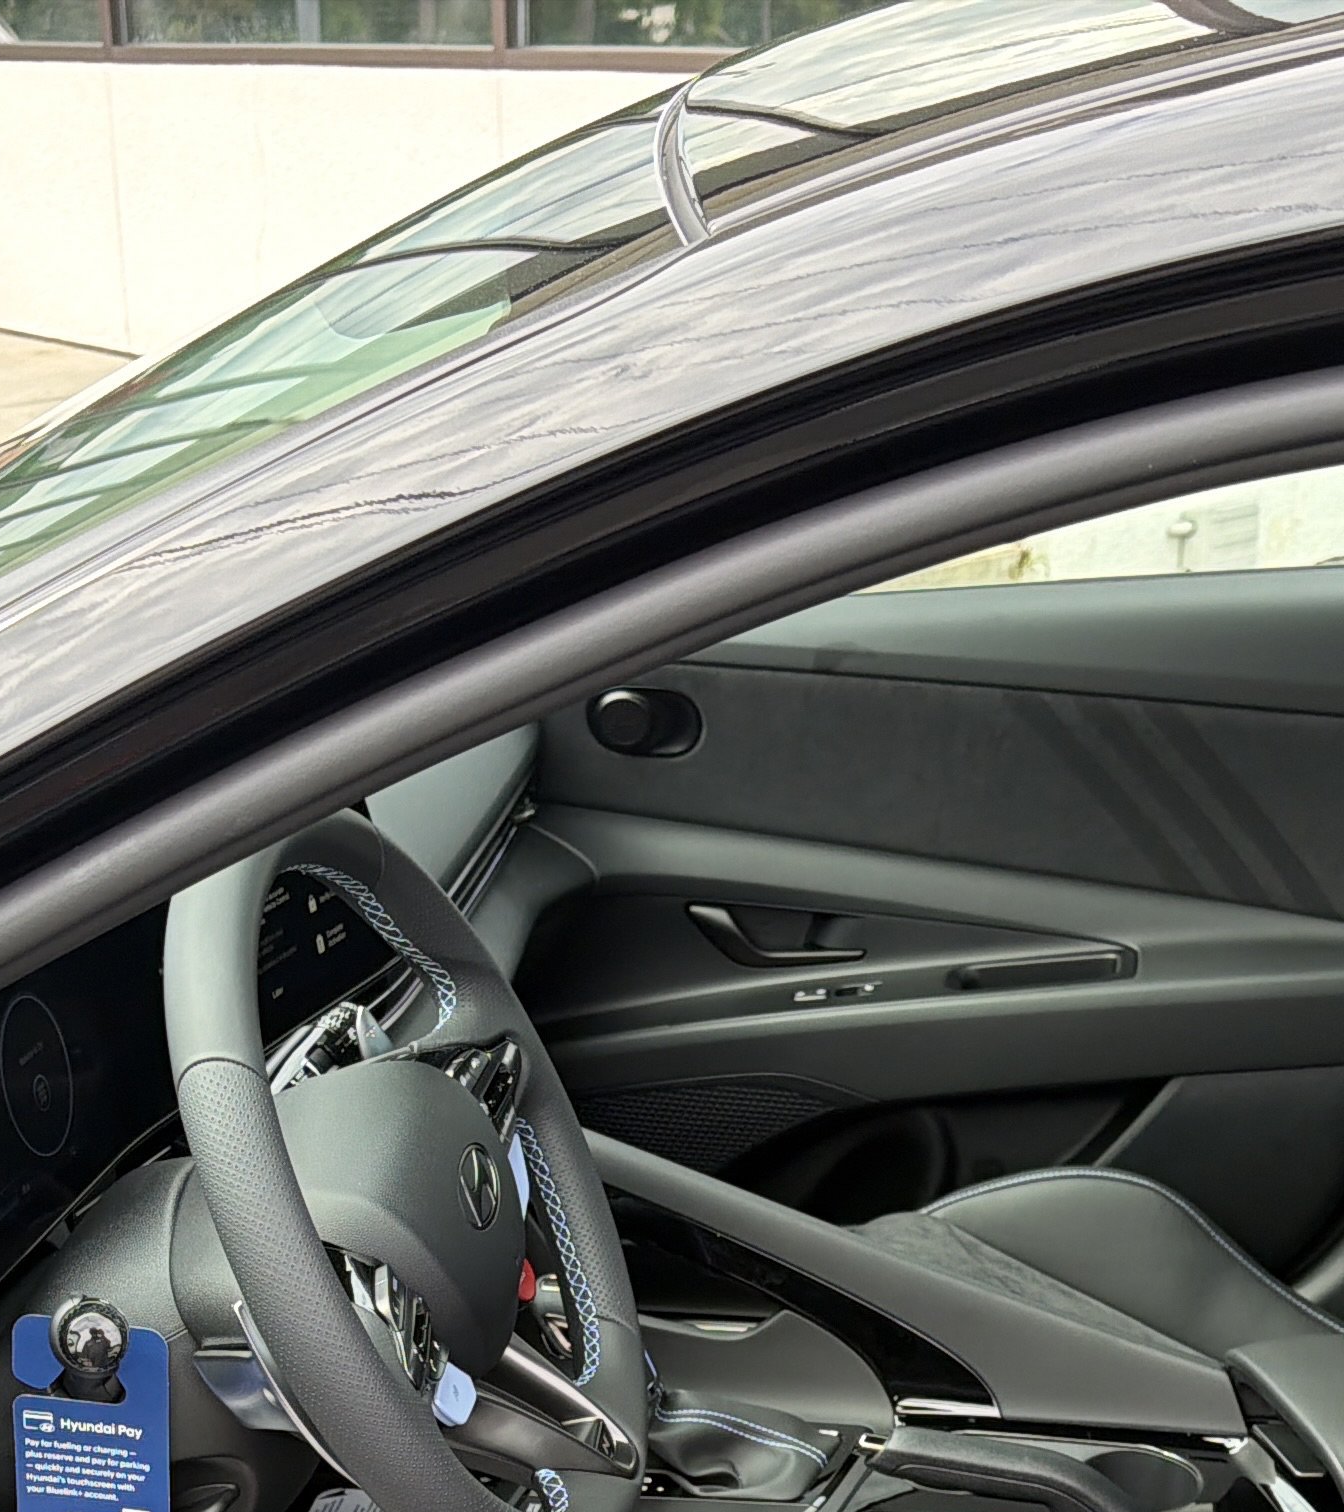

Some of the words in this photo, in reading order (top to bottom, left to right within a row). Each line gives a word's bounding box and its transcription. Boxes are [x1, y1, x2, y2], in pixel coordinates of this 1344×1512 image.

[60, 1418, 116, 1435] Hyundai
[117, 1424, 143, 1440] Pay
[25, 1437, 40, 1448] Pay
[41, 1439, 52, 1448] for
[53, 1440, 82, 1452] fueling
[93, 1446, 128, 1458] charging
[25, 1450, 43, 1459] plus
[44, 1452, 73, 1462] reserve
[74, 1455, 90, 1463] and
[91, 1458, 106, 1466] pay
[107, 1458, 118, 1467] for
[119, 1461, 151, 1473] parking
[34, 1462, 64, 1473] quickly
[65, 1465, 80, 1474] and
[81, 1467, 115, 1479] securely
[127, 1474, 146, 1482] your
[25, 1473, 66, 1483] Hyundai's
[66, 1477, 116, 1489] touchscreen
[117, 1483, 135, 1492] with
[26, 1486, 45, 1494] your
[84, 1491, 119, 1501] account.
